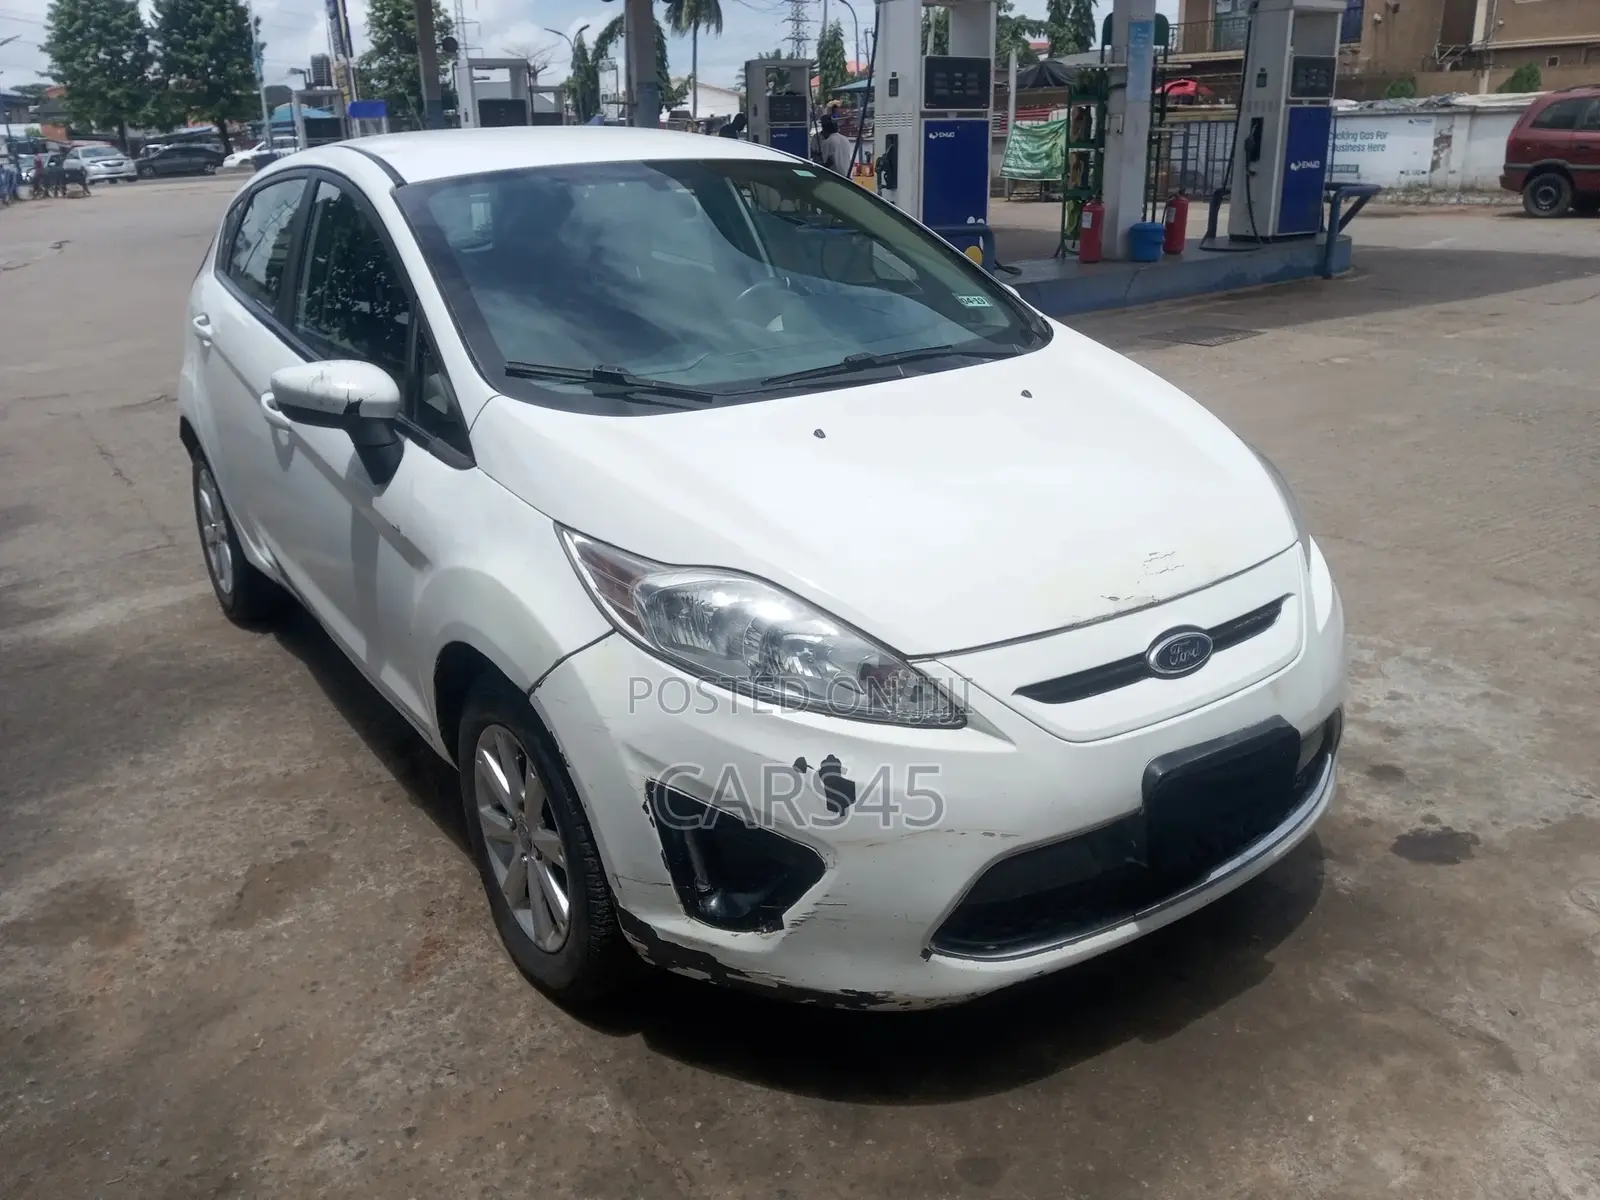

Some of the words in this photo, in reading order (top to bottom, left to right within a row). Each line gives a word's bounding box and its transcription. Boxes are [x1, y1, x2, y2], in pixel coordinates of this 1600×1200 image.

[1360, 131, 1374, 140] Gas
[1376, 131, 1388, 140] For
[1367, 143, 1386, 152] Here
[1169, 640, 1201, 666] Ford
